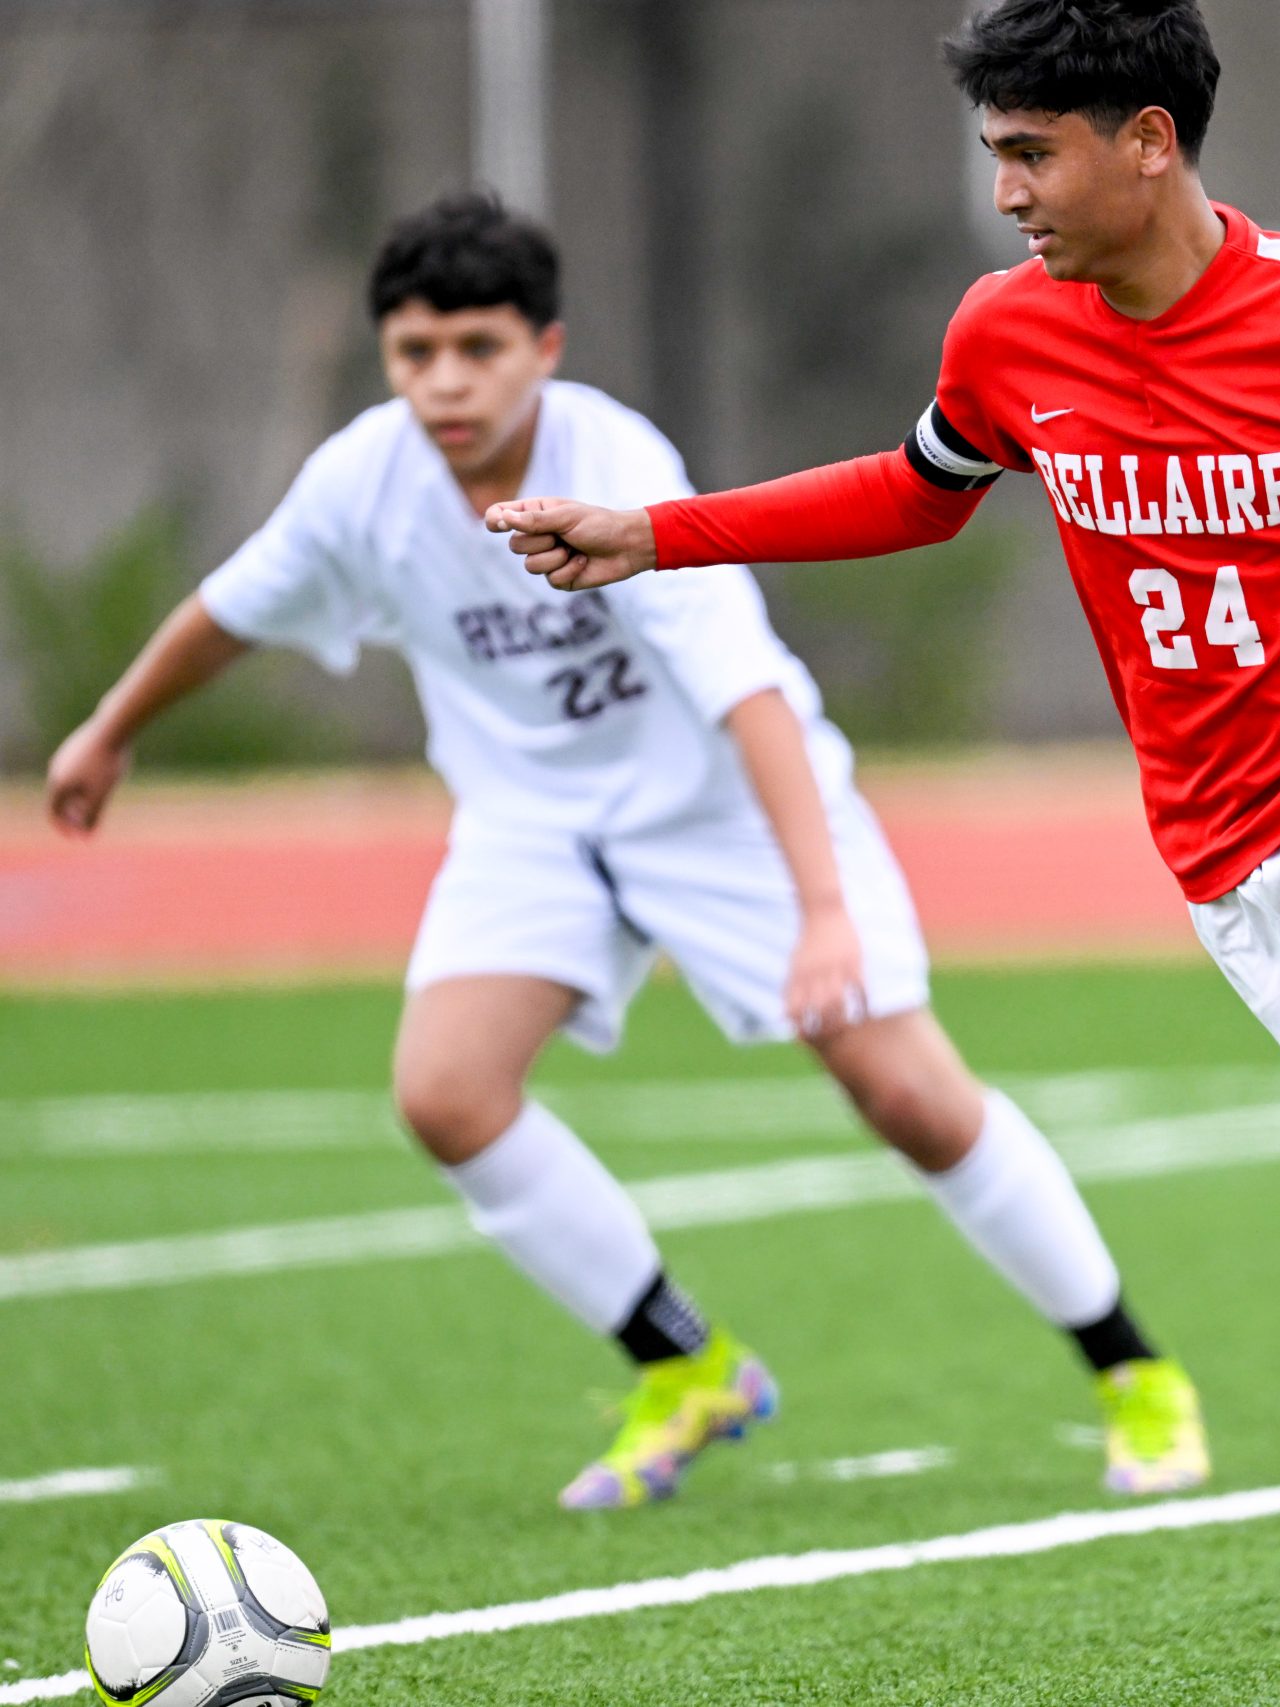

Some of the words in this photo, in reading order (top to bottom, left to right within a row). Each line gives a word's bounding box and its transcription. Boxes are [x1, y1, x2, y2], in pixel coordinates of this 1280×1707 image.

[1128, 565, 1266, 670] 24
[545, 648, 649, 722] 22
[229, 1658, 243, 1666] SIZE
